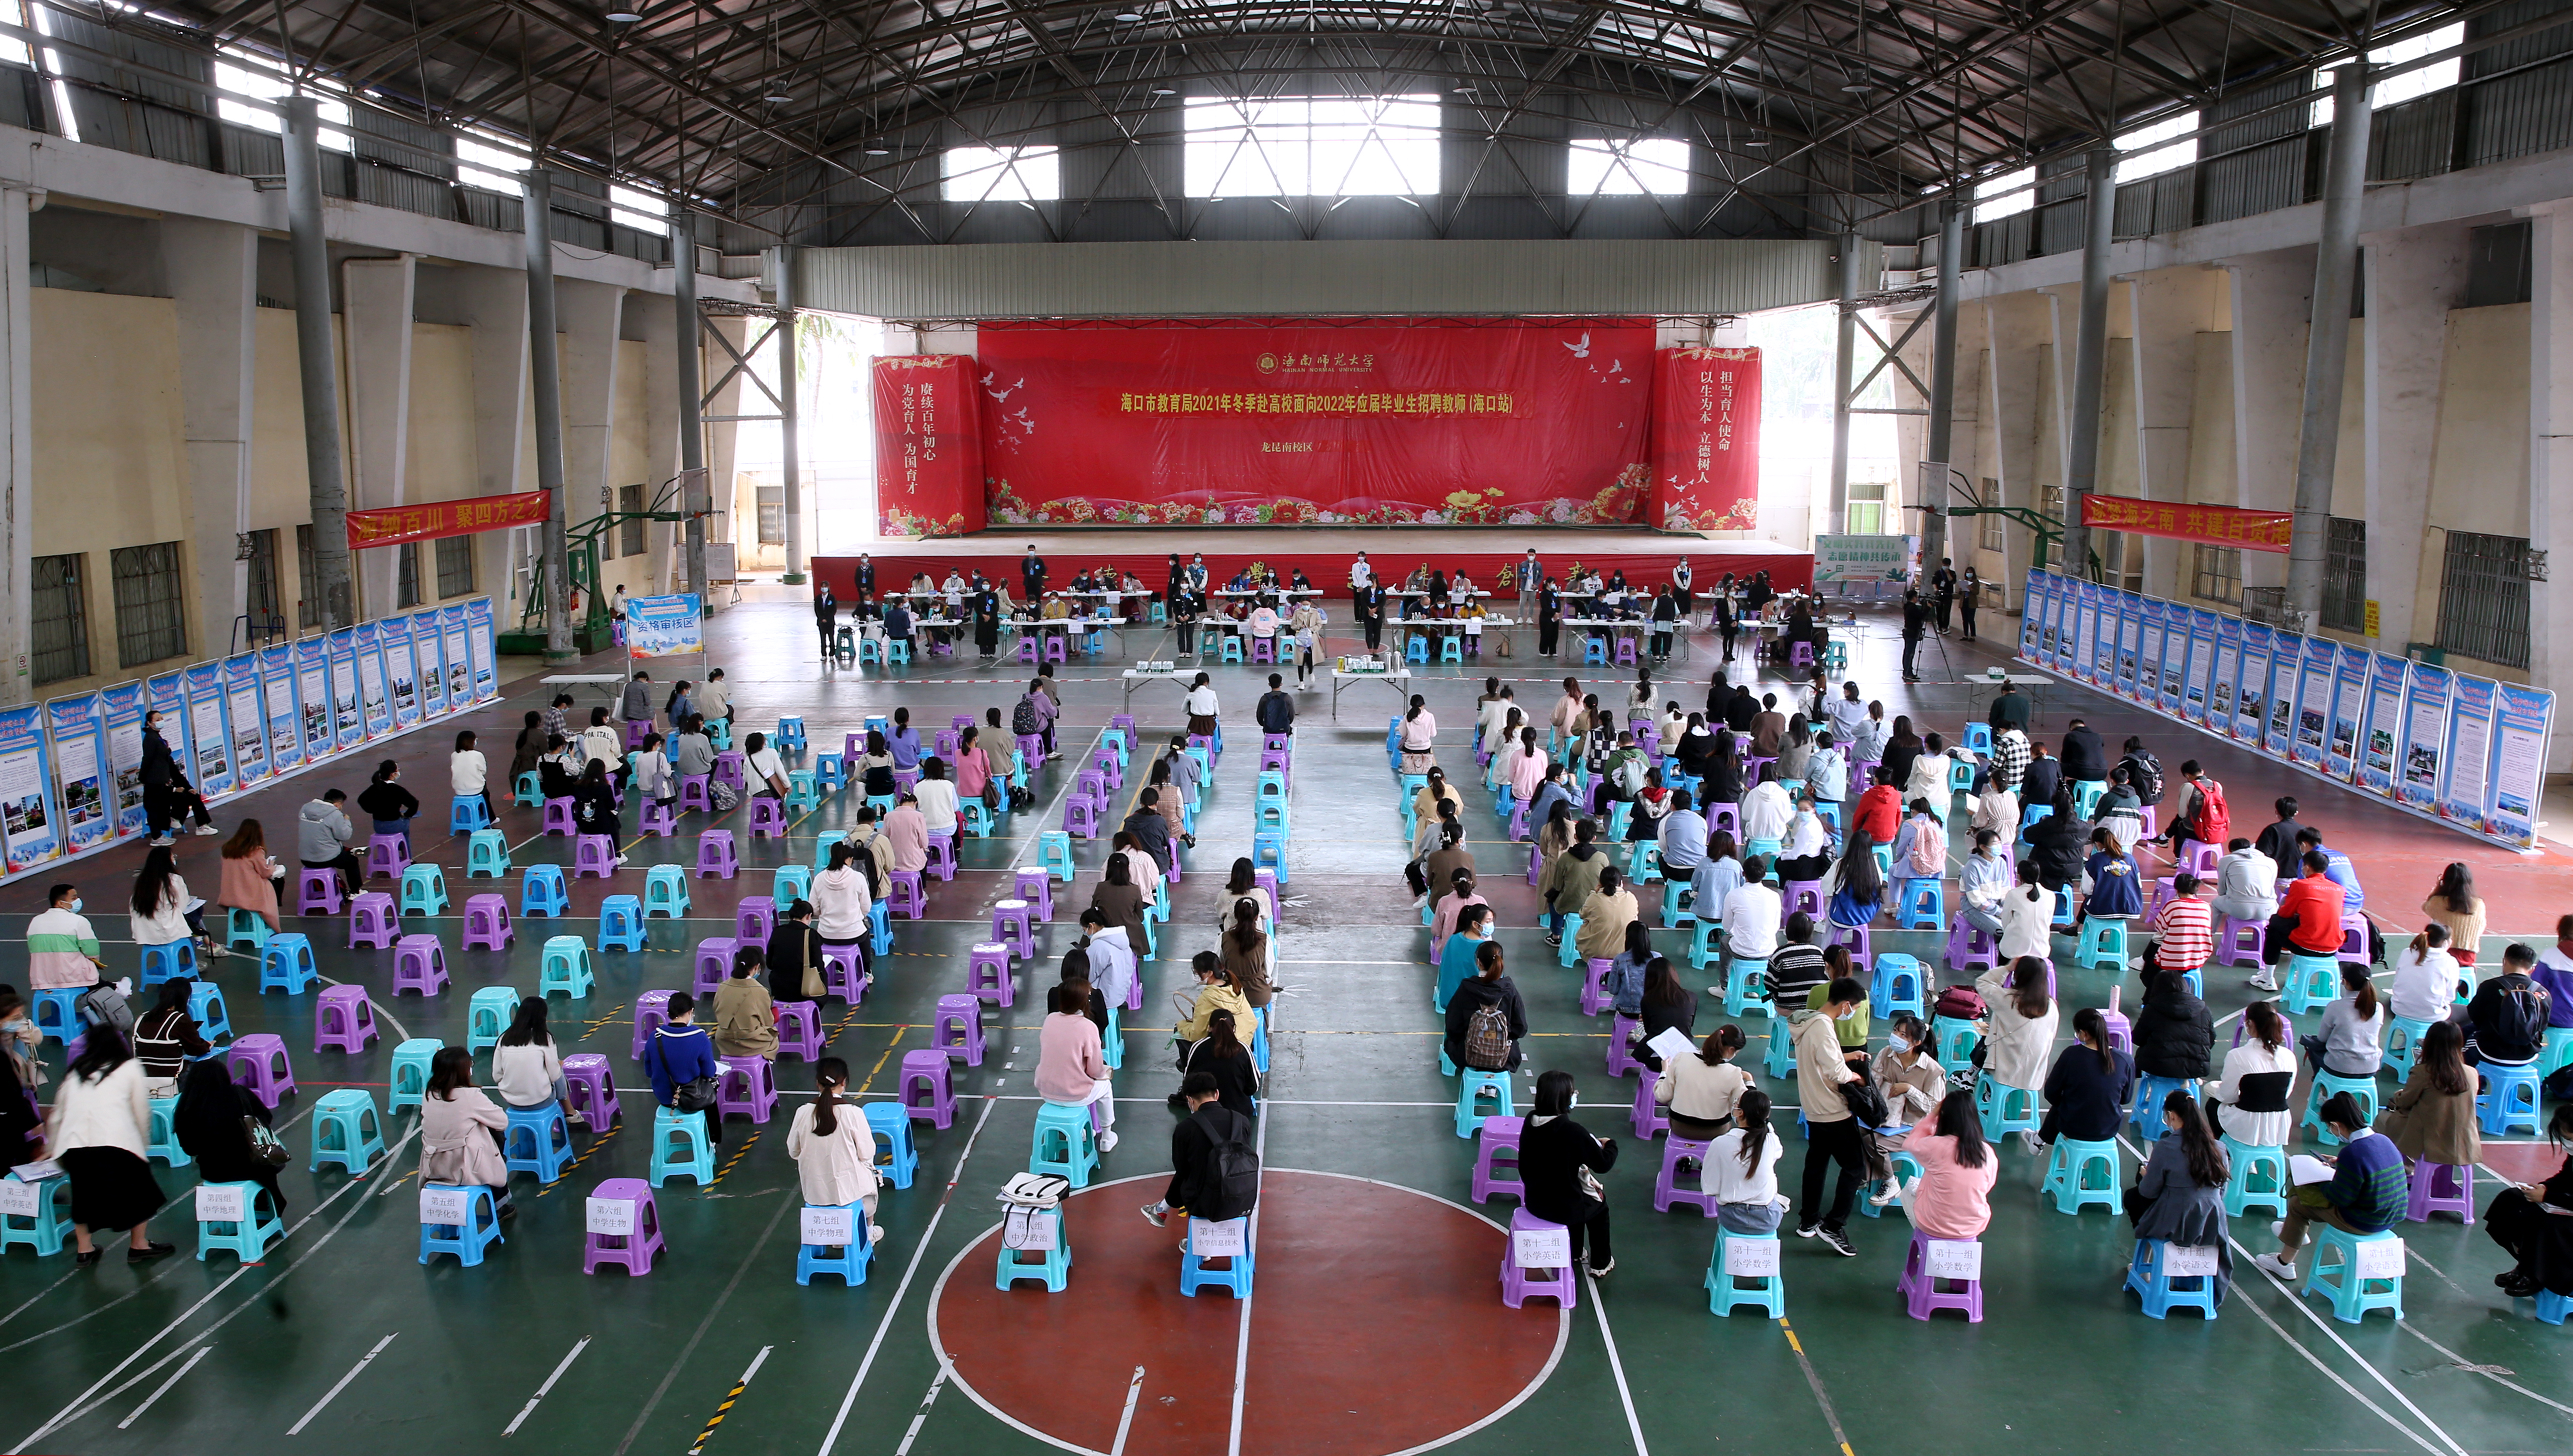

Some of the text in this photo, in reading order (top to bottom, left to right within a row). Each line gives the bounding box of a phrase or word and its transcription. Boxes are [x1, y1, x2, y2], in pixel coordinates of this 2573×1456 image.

[1718, 371, 1733, 451] 担当育人使命
[920, 382, 936, 461] 赓续百年初心
[1697, 371, 1713, 484] 以生为本 立德树人
[902, 383, 918, 494] 为党育人 为国育才
[1261, 442, 1313, 453] 龙昆南校区
[637, 617, 694, 633] 资格审核区
[7, 1187, 29, 1197] 第三组
[207, 1194, 232, 1202] 第四组
[431, 1197, 456, 1206] 第五组
[4, 1199, 33, 1209] 中学英语
[203, 1205, 237, 1214] 中学地理
[427, 1209, 459, 1218] 中学化学
[596, 1205, 622, 1215] 第六组
[593, 1218, 627, 1228] 中学生物
[813, 1215, 840, 1225] 第七组
[808, 1228, 844, 1237] 中学物理
[1199, 1227, 1236, 1236] 第十三组
[1011, 1233, 1048, 1242] 中学政治
[1522, 1238, 1561, 1247] 第十二组
[1523, 1250, 1561, 1260] 小学英语
[1733, 1245, 1772, 1256] 第十一组
[1935, 1249, 1973, 1259] 第十一组
[2177, 1247, 2205, 1257] 第十组
[2369, 1247, 2394, 1258] 第十组
[1733, 1258, 1771, 1268] 小学数学
[1934, 1262, 1973, 1272] 小学数学
[2172, 1260, 2211, 1269] 小学语文
[2364, 1261, 2399, 1271] 小学语文
